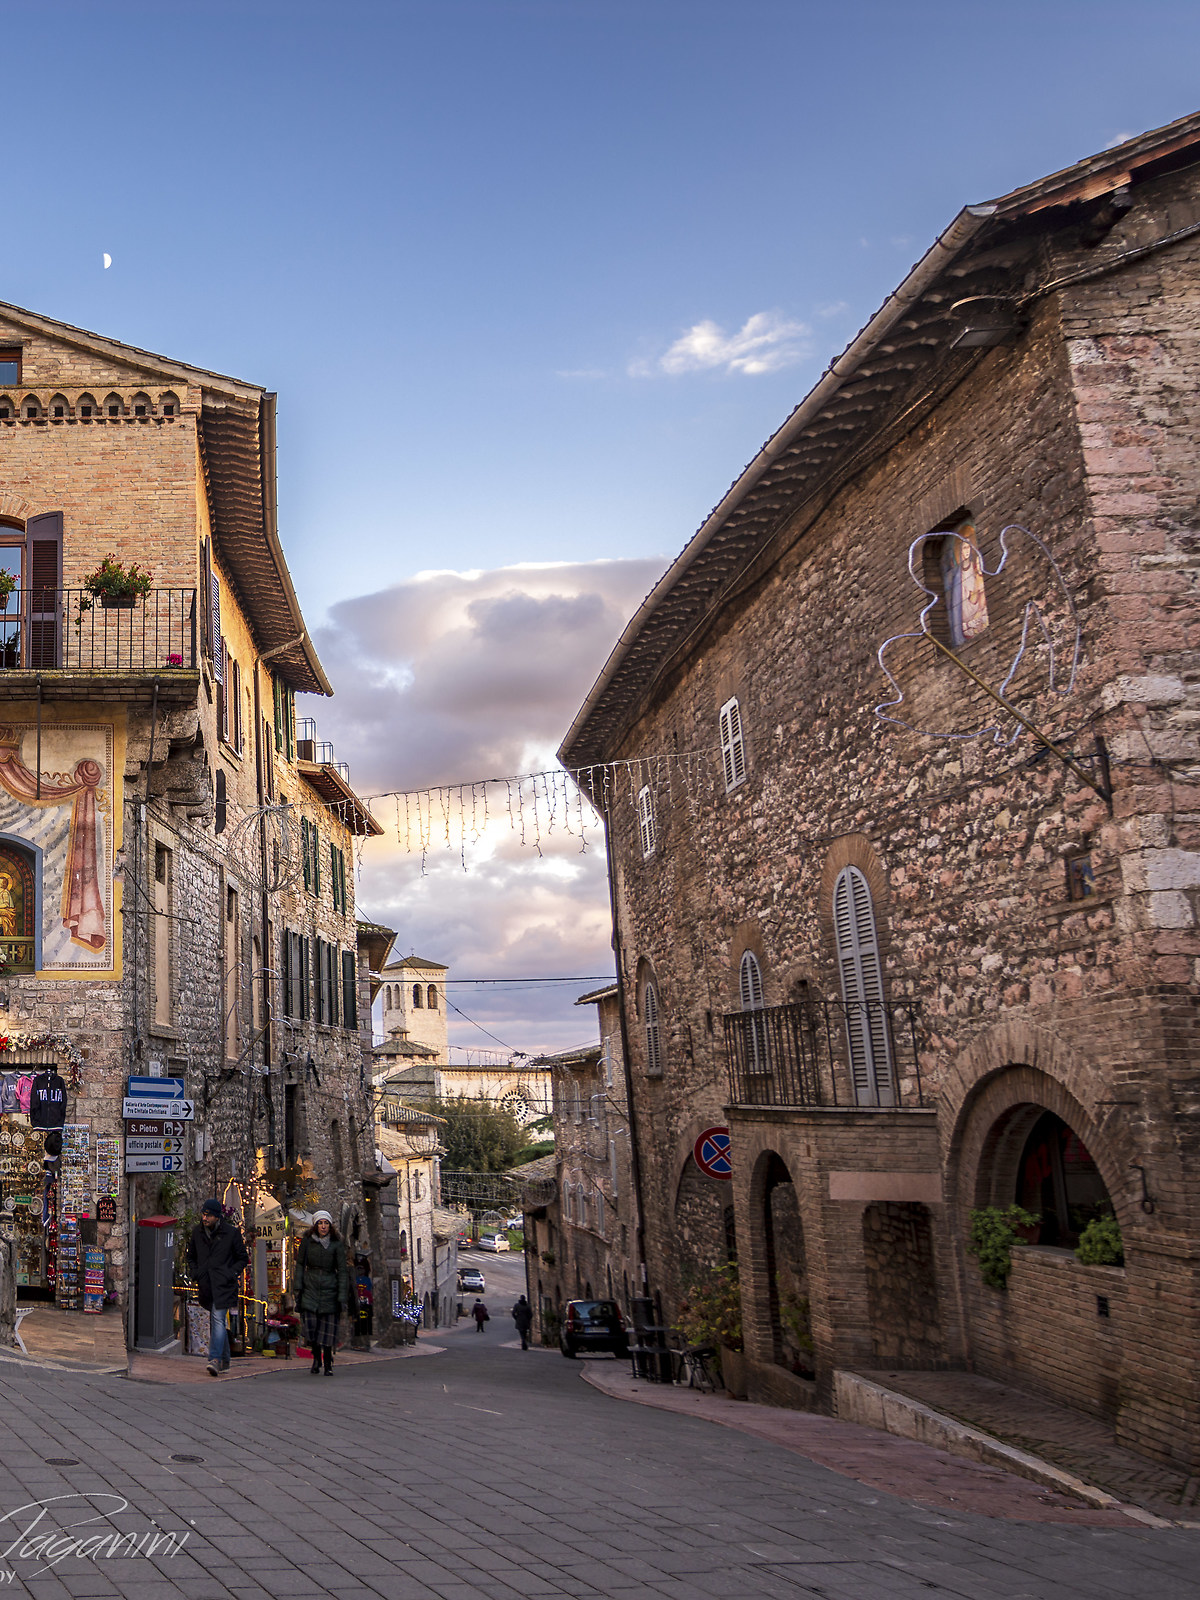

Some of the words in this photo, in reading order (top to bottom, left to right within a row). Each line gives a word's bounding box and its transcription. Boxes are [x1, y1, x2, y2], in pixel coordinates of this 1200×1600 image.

[131, 1124, 138, 1132] S.
[139, 1124, 159, 1133] Pietro
[128, 1140, 144, 1149] ufficio
[144, 1140, 162, 1150] postale
[257, 1226, 273, 1237] BAR
